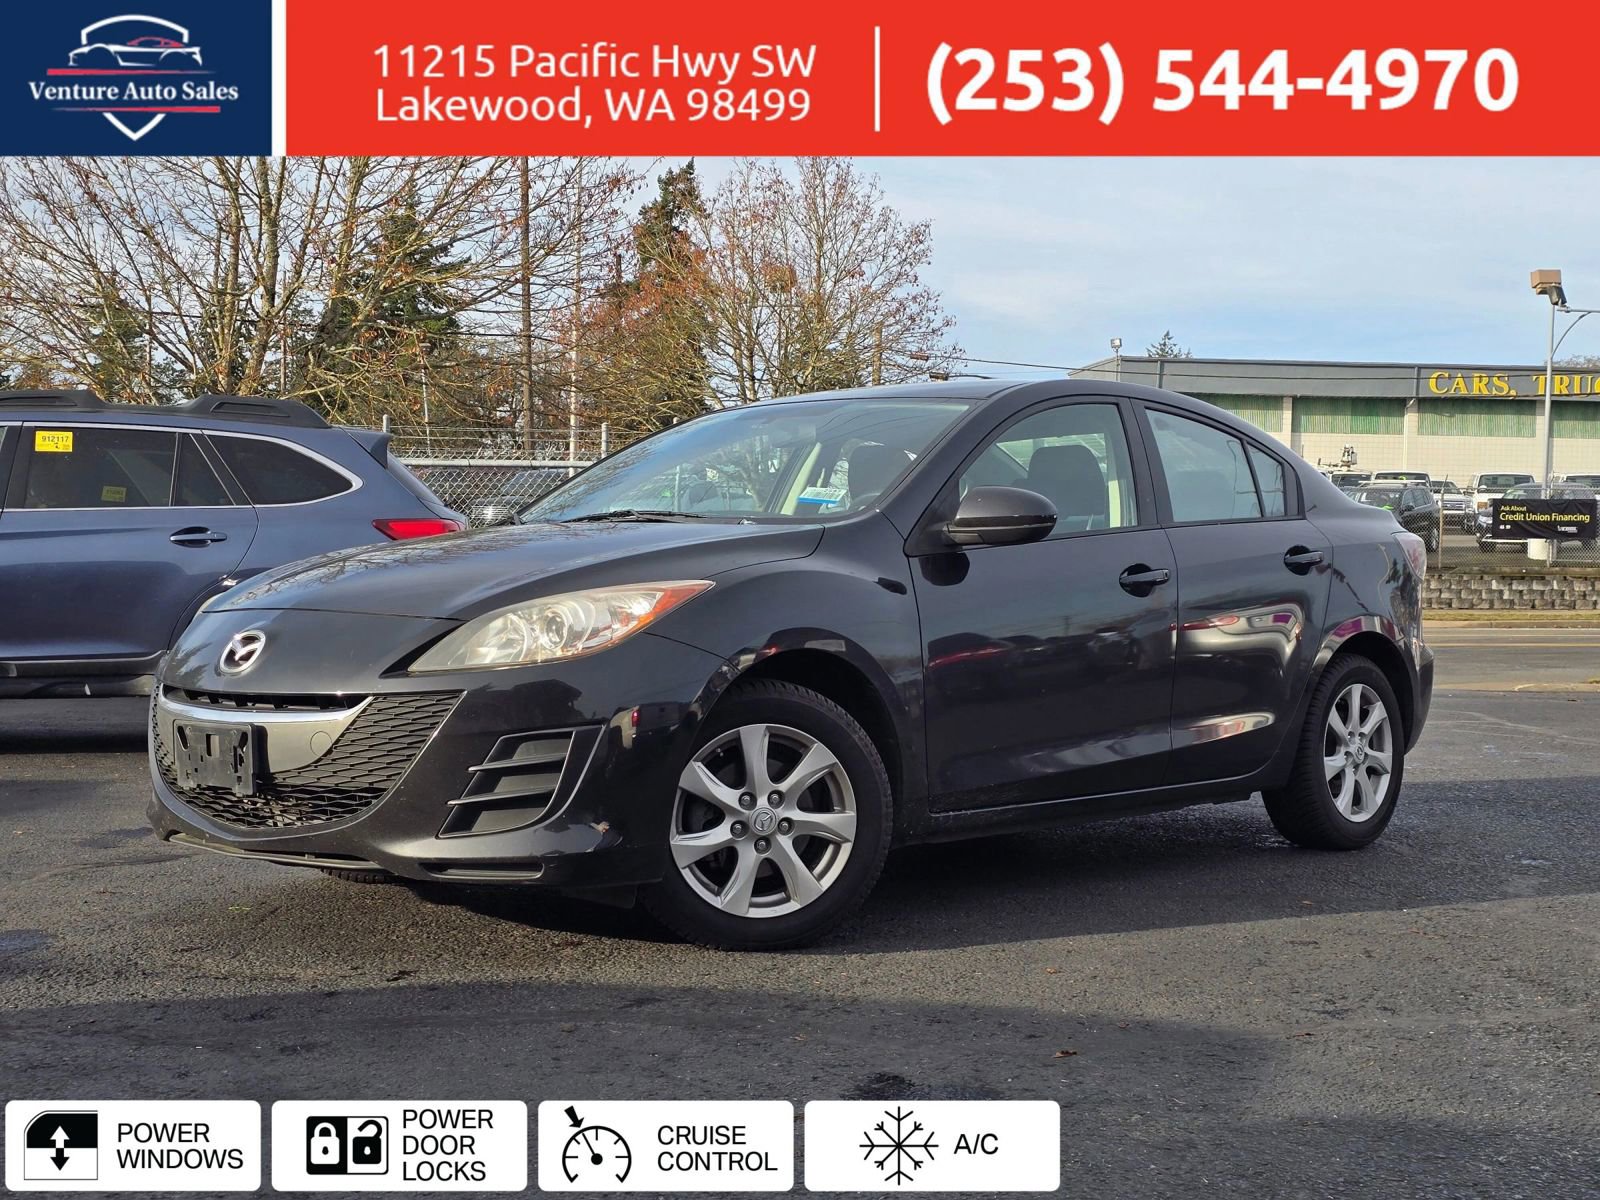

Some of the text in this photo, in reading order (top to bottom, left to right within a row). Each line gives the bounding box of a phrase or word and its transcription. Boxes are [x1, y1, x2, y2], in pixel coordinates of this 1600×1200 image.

[1500, 513, 1590, 523] Credit Union Financing
